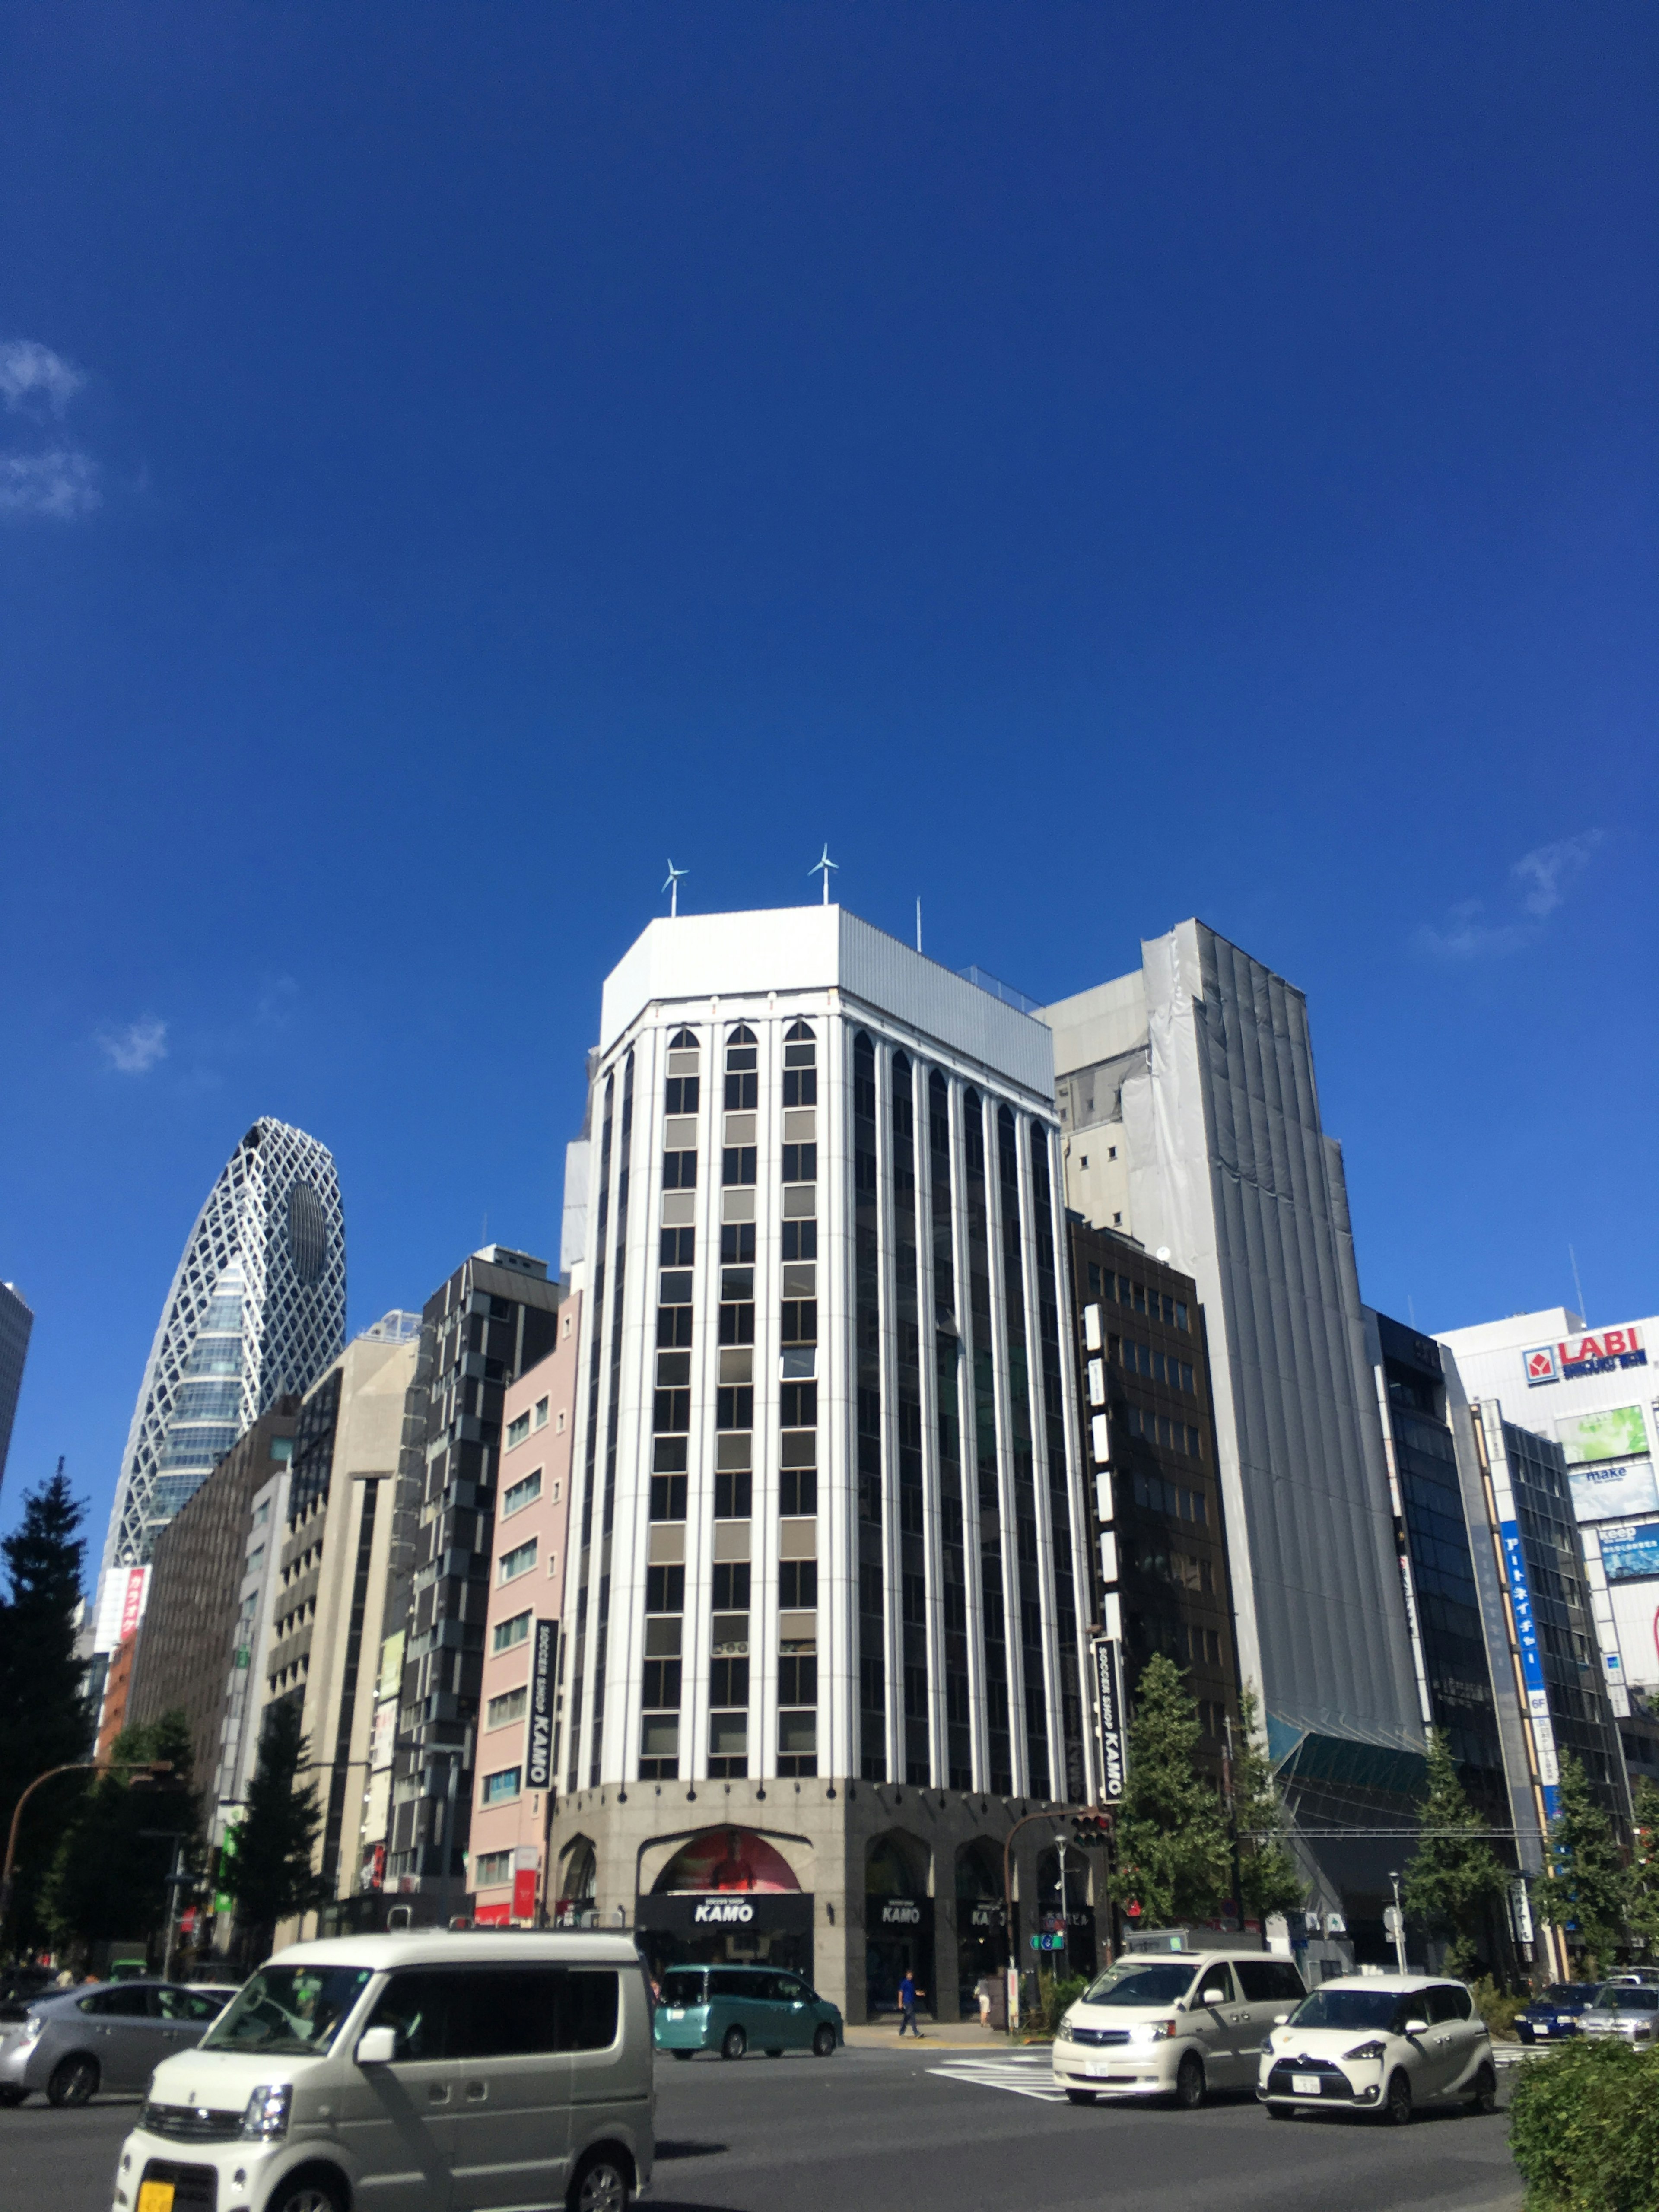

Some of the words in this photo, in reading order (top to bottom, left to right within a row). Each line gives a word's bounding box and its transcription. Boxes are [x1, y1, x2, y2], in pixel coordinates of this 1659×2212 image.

[1558, 1328, 1638, 1365] LABI
[1586, 1467, 1627, 1481] make
[1599, 1527, 1636, 1540] keep
[1505, 1538, 1536, 1664] アートネイチャー
[1099, 1647, 1110, 1694] SOCCER
[1103, 1695, 1113, 1730] SHOP
[1532, 1699, 1545, 1709] 6F
[531, 1715, 549, 1783] KAMO
[1105, 1731, 1122, 1796] KAMO
[695, 1904, 753, 1922] KAMO
[882, 1907, 920, 1924] KAMO
